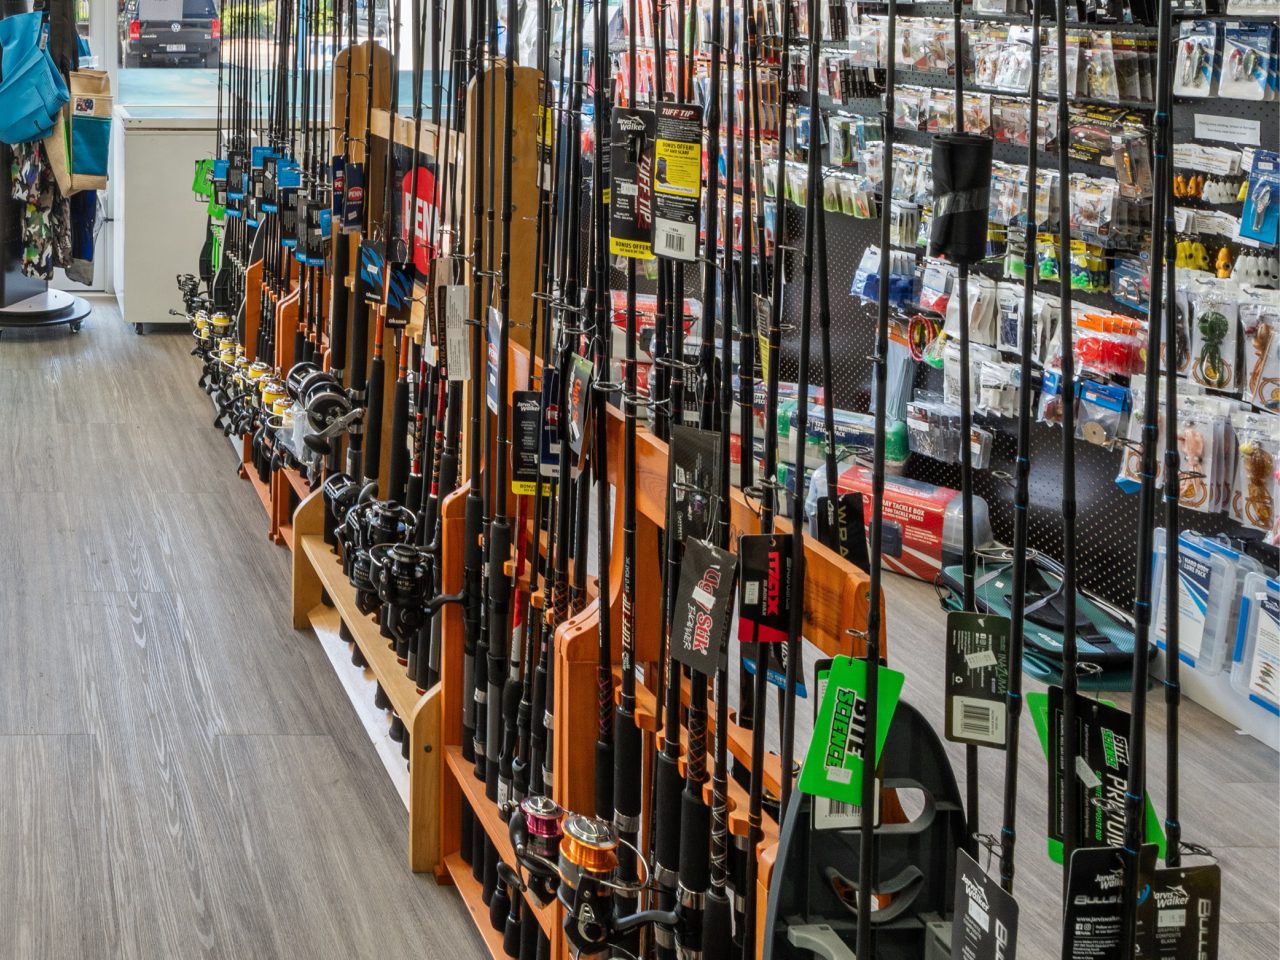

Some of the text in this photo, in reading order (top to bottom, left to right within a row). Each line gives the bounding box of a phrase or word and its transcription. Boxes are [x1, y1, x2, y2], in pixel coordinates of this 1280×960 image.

[620, 121, 646, 131] Walker
[662, 107, 694, 117] TUFF TIP
[639, 154, 651, 191] TUFF
[348, 191, 363, 199] PENN
[639, 193, 651, 223] TIP
[405, 191, 441, 248] PENN
[893, 501, 925, 516] TACKLE BOX
[622, 593, 632, 616] TIP
[622, 617, 631, 649] TUFF
[692, 612, 714, 655] Stik
[825, 687, 856, 769] SCIENCE
[1102, 727, 1118, 769] SCIENCE
[1114, 734, 1130, 767] BITE
[1094, 874, 1115, 883] Jarvis
[965, 884, 990, 912] Walker
[1156, 896, 1189, 908] Walker
